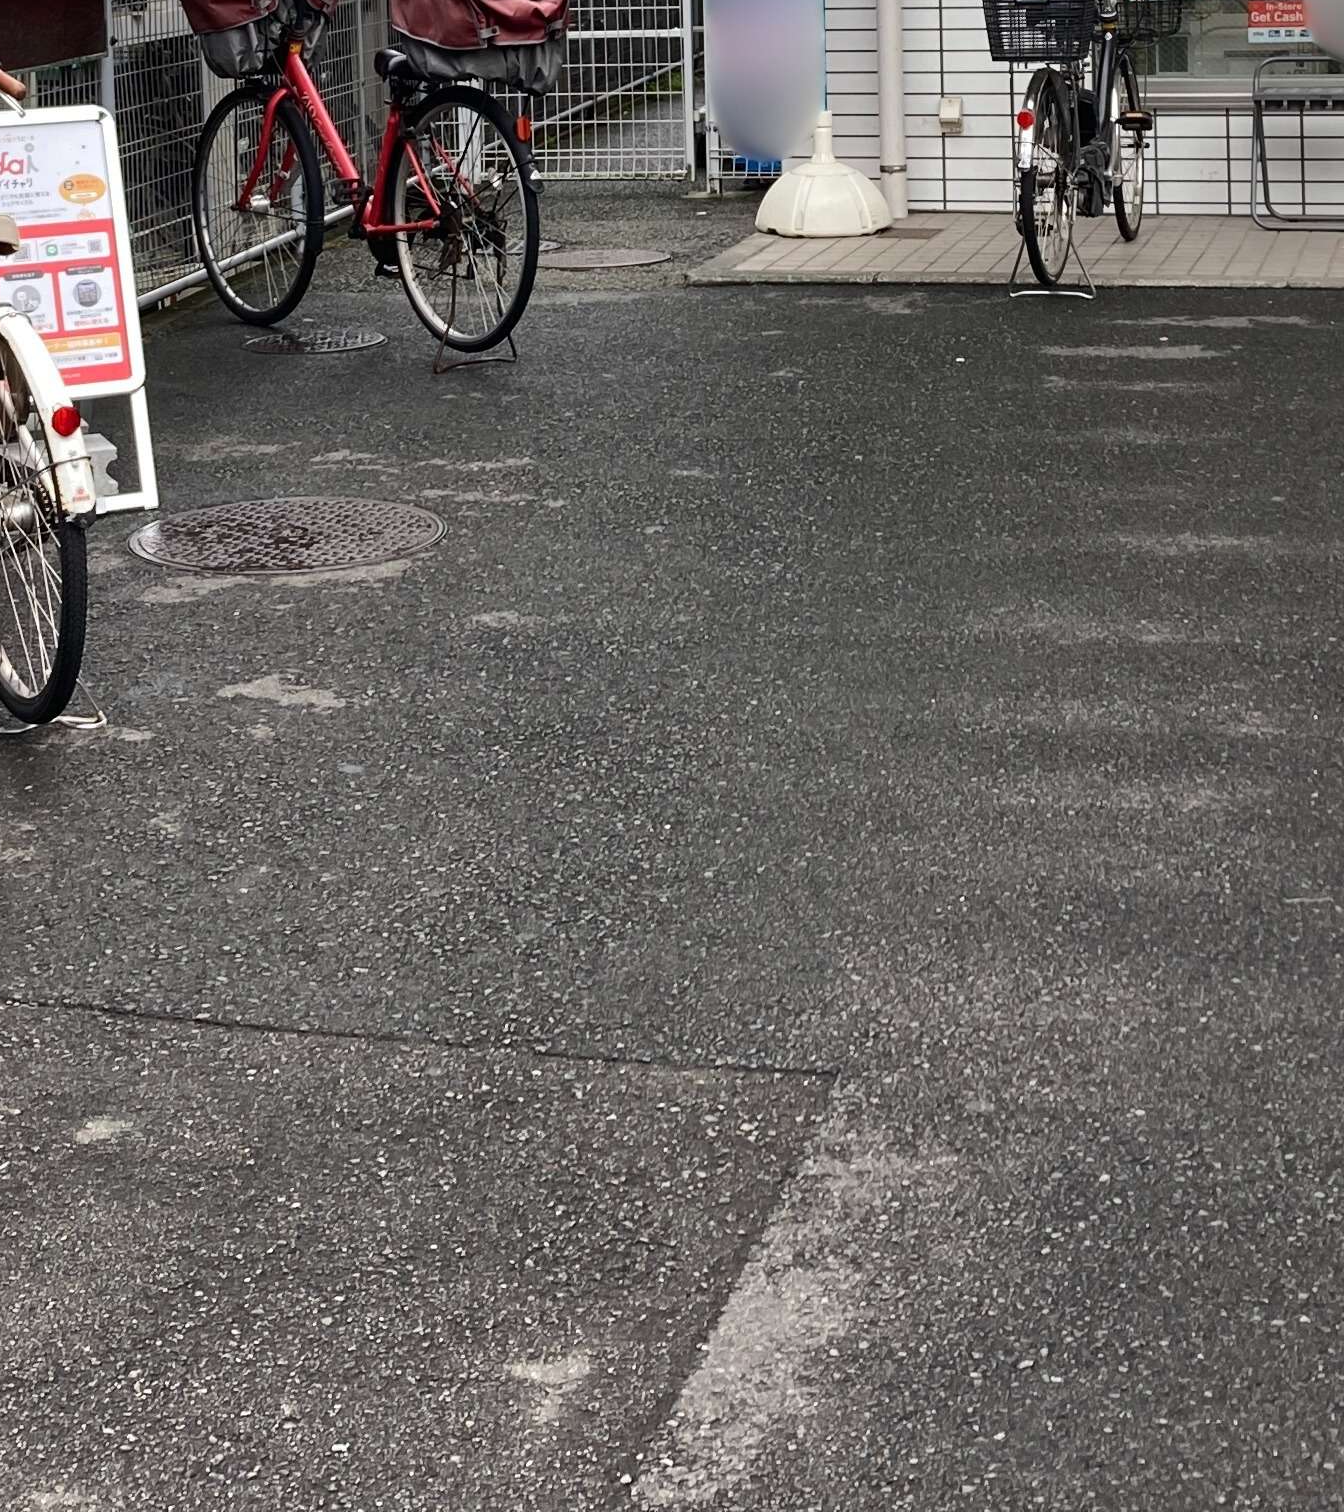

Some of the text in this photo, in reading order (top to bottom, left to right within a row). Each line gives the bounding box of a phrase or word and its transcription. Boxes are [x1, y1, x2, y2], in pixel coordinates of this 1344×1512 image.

[1265, 2, 1303, 11] In-Store
[1251, 11, 1304, 23] Get Cash
